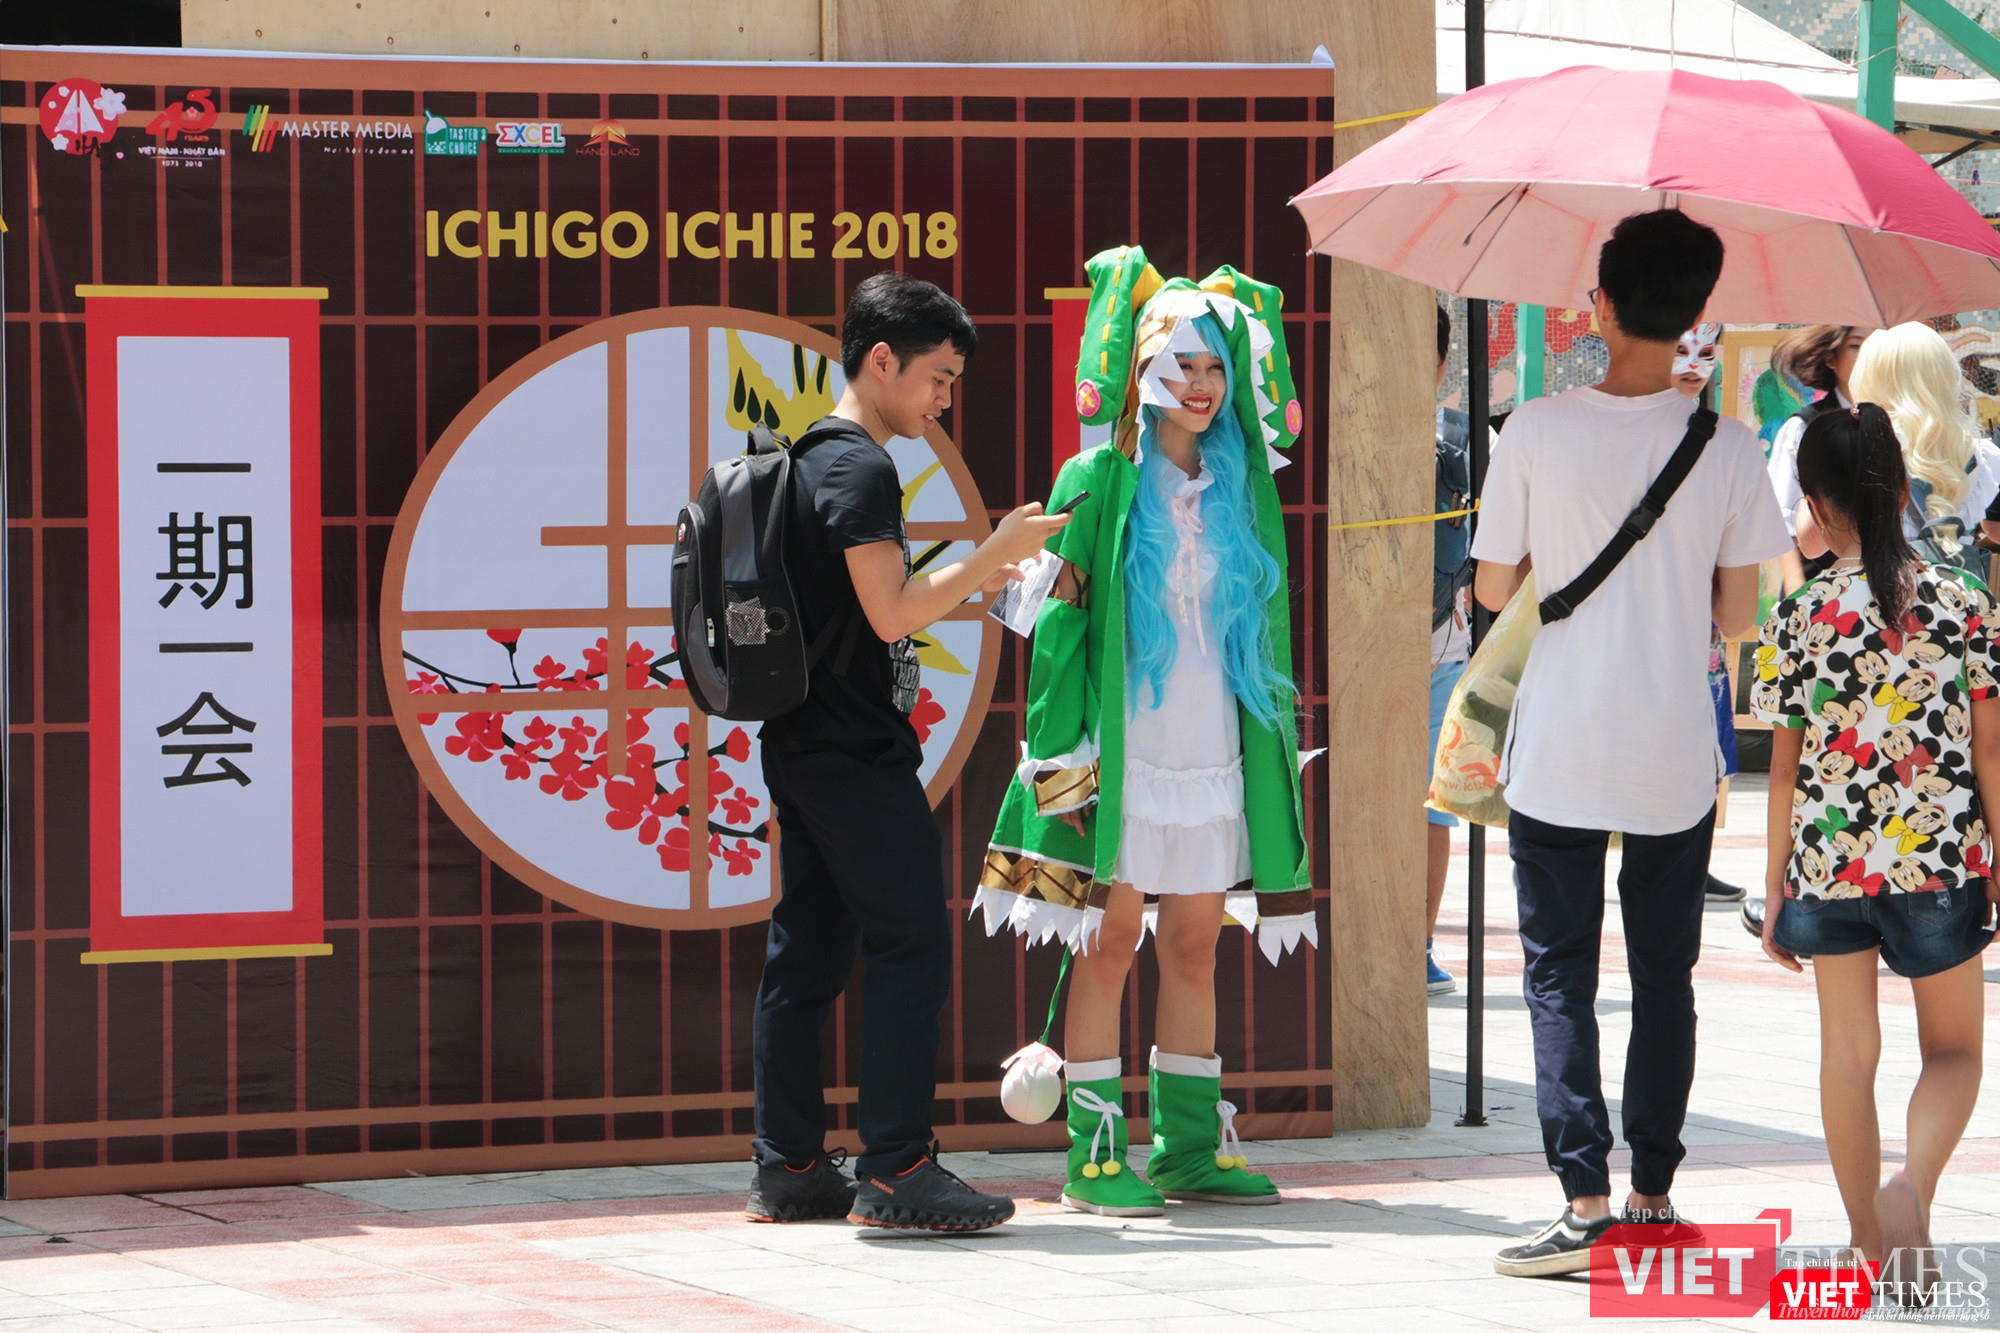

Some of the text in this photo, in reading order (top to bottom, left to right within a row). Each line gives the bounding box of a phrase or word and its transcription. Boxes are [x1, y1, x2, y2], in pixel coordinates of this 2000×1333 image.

[282, 121, 414, 140] MASTER MEDIA
[449, 141, 477, 154] CHOICE
[426, 210, 958, 260] ICHIGO ICHIE 2018
[156, 462, 257, 789] 一期一会
[870, 1178, 895, 1195] Reebok
